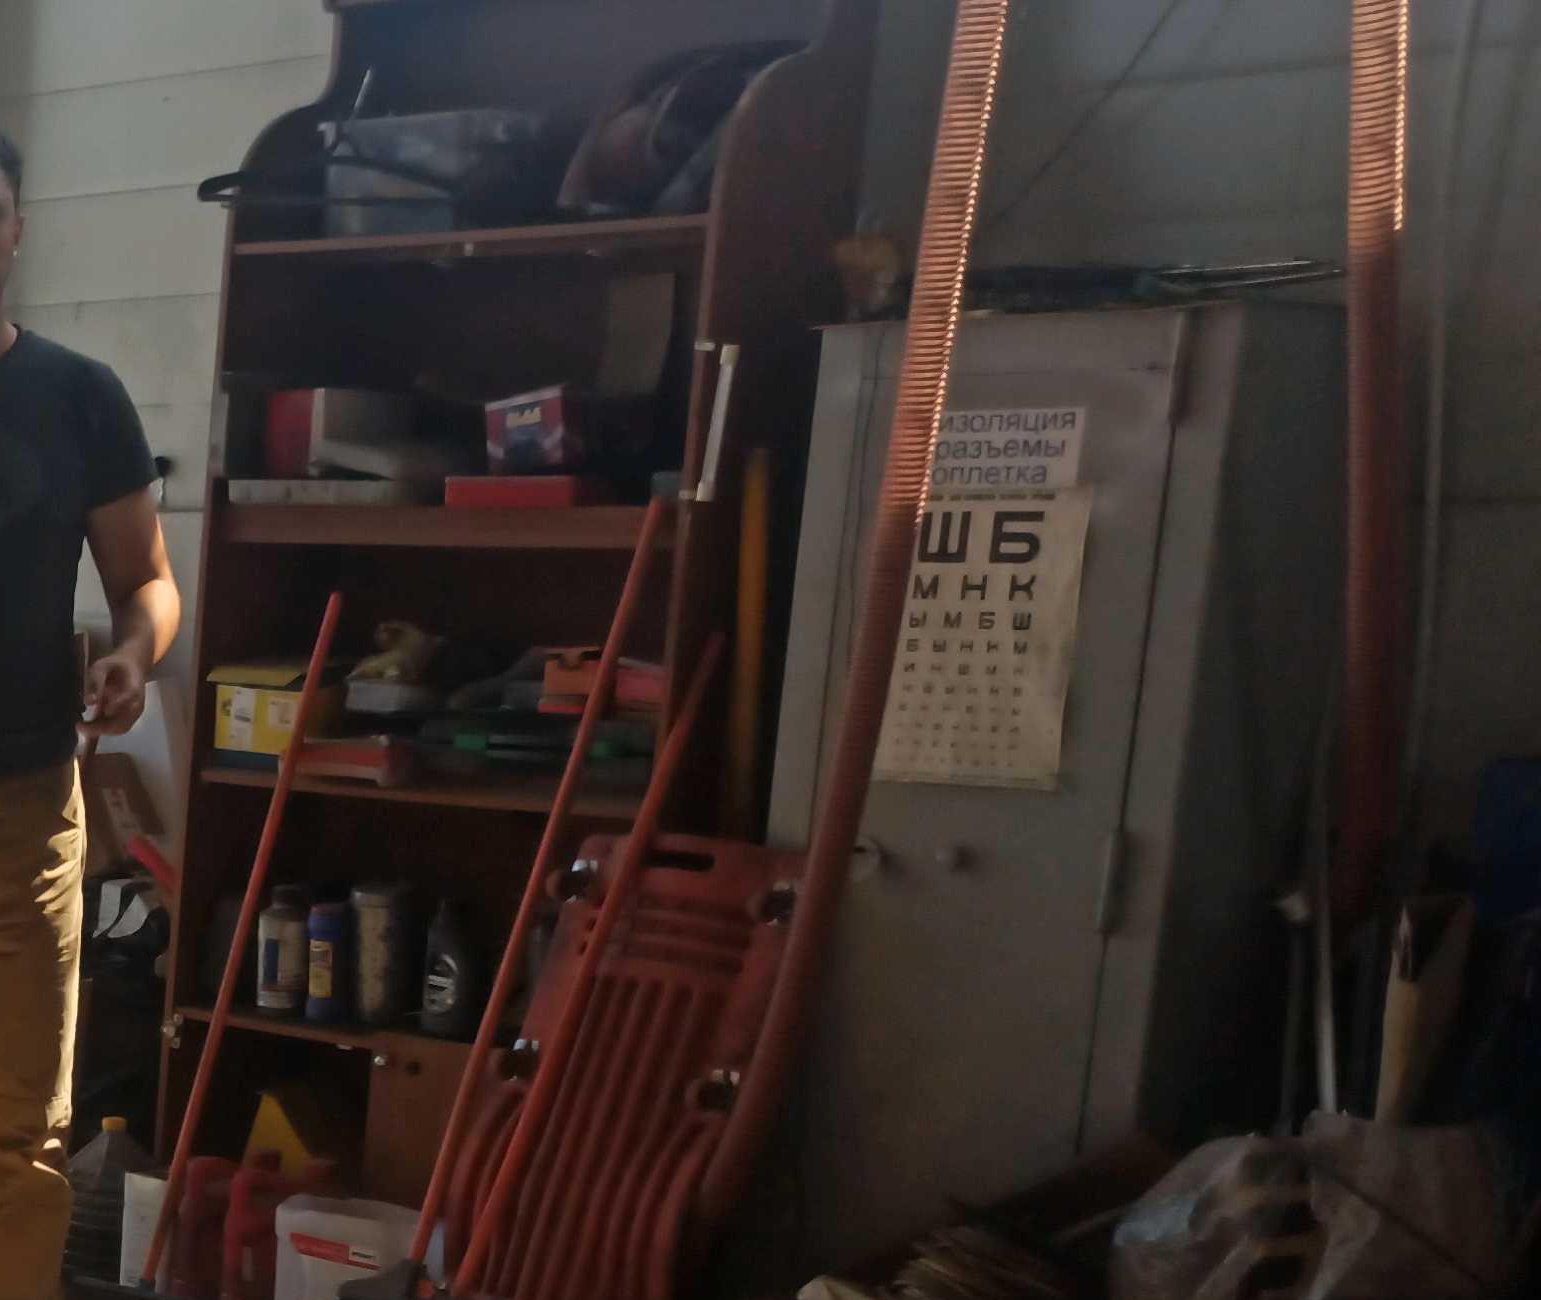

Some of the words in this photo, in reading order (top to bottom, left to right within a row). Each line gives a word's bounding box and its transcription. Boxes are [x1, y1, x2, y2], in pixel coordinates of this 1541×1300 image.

[939, 411, 1077, 434] изоляция
[935, 438, 1065, 461] разъемы
[931, 464, 1048, 486] оплетка
[918, 511, 972, 563] Ш
[988, 511, 1046, 563] Б
[912, 574, 940, 600] М
[960, 574, 988, 601] Н
[1008, 574, 1037, 601] К
[978, 611, 996, 630] Б
[1012, 612, 1032, 631] Ш
